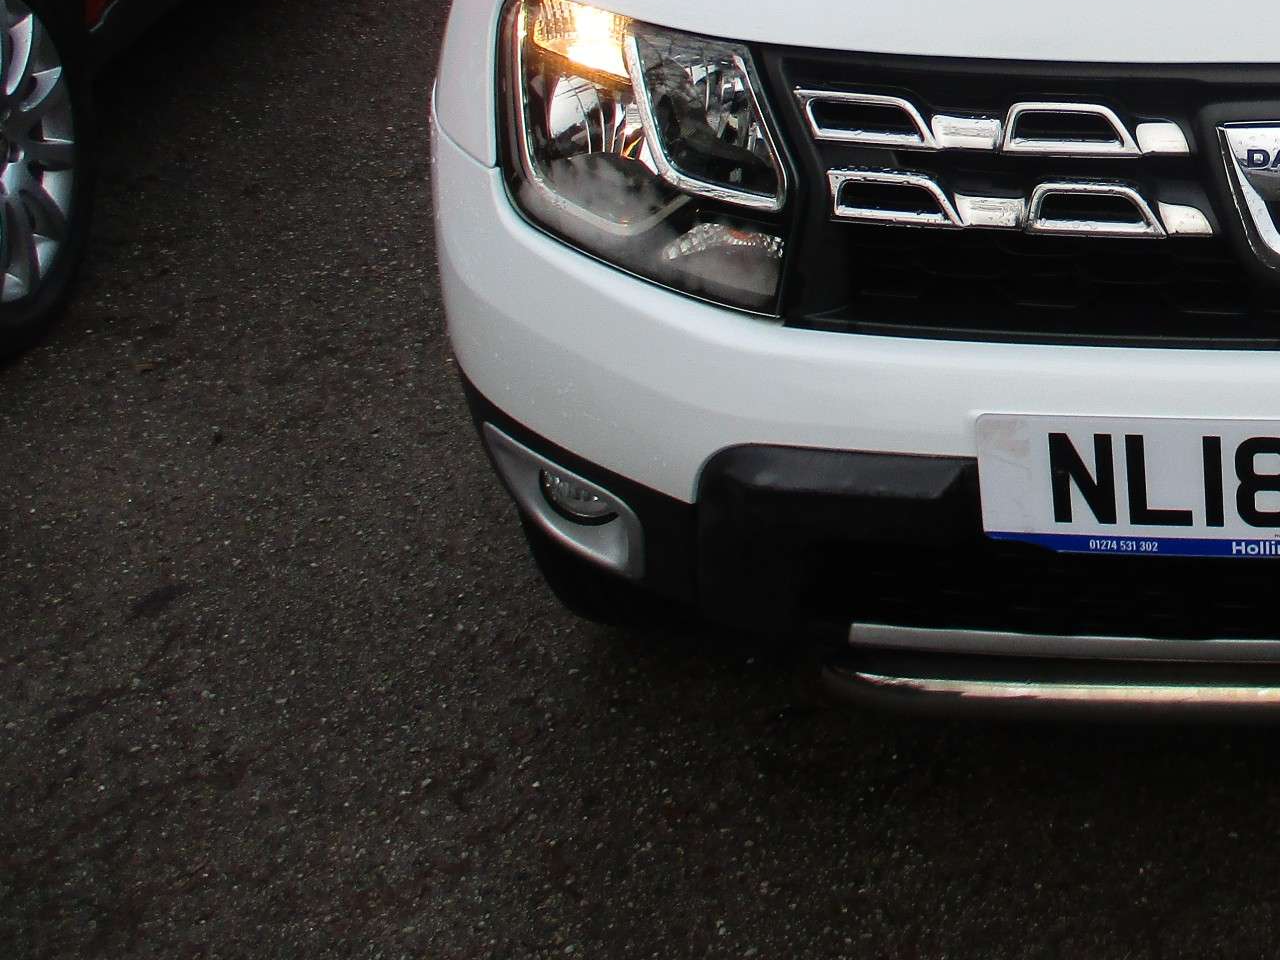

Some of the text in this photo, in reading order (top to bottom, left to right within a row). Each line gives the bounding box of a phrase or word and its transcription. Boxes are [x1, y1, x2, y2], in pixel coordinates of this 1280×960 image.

[1089, 540, 1158, 551] 01274 531 302
